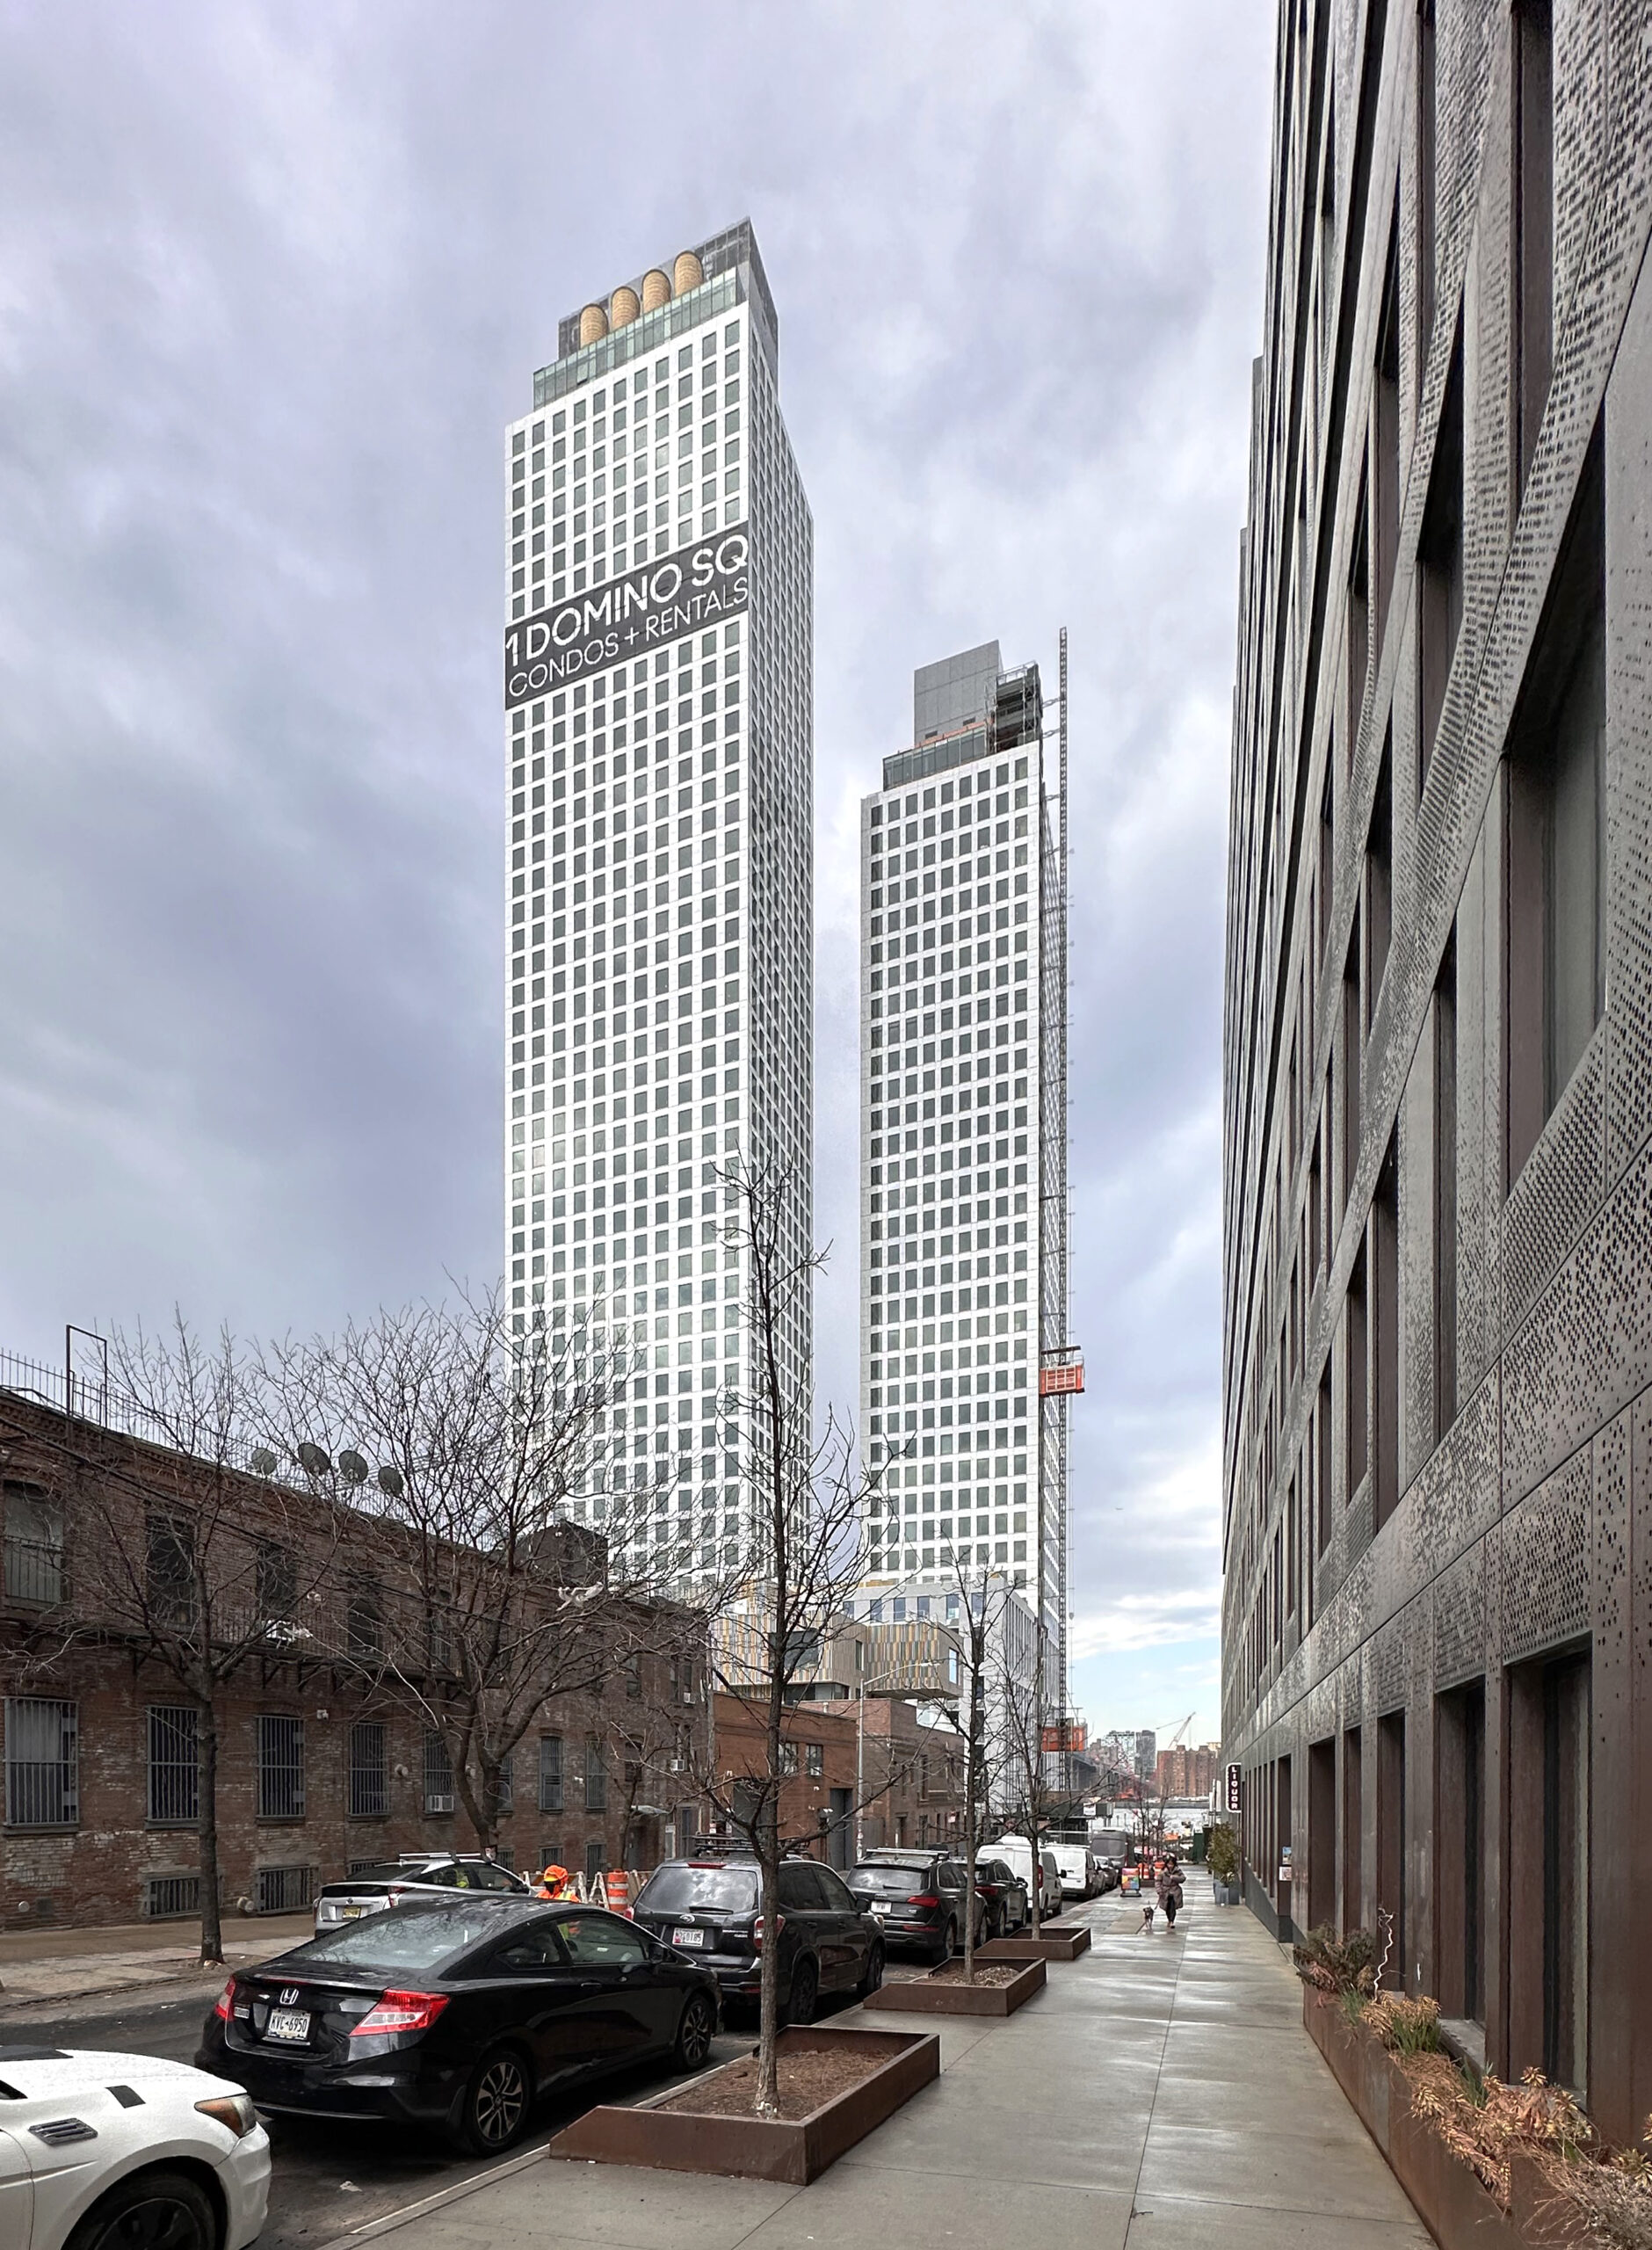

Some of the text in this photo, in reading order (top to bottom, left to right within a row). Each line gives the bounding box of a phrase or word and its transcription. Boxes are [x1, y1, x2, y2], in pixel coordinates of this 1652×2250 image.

[505, 533, 749, 666] 1 DOMINO SQ
[509, 577, 749, 697] CONDOS + RENTALS
